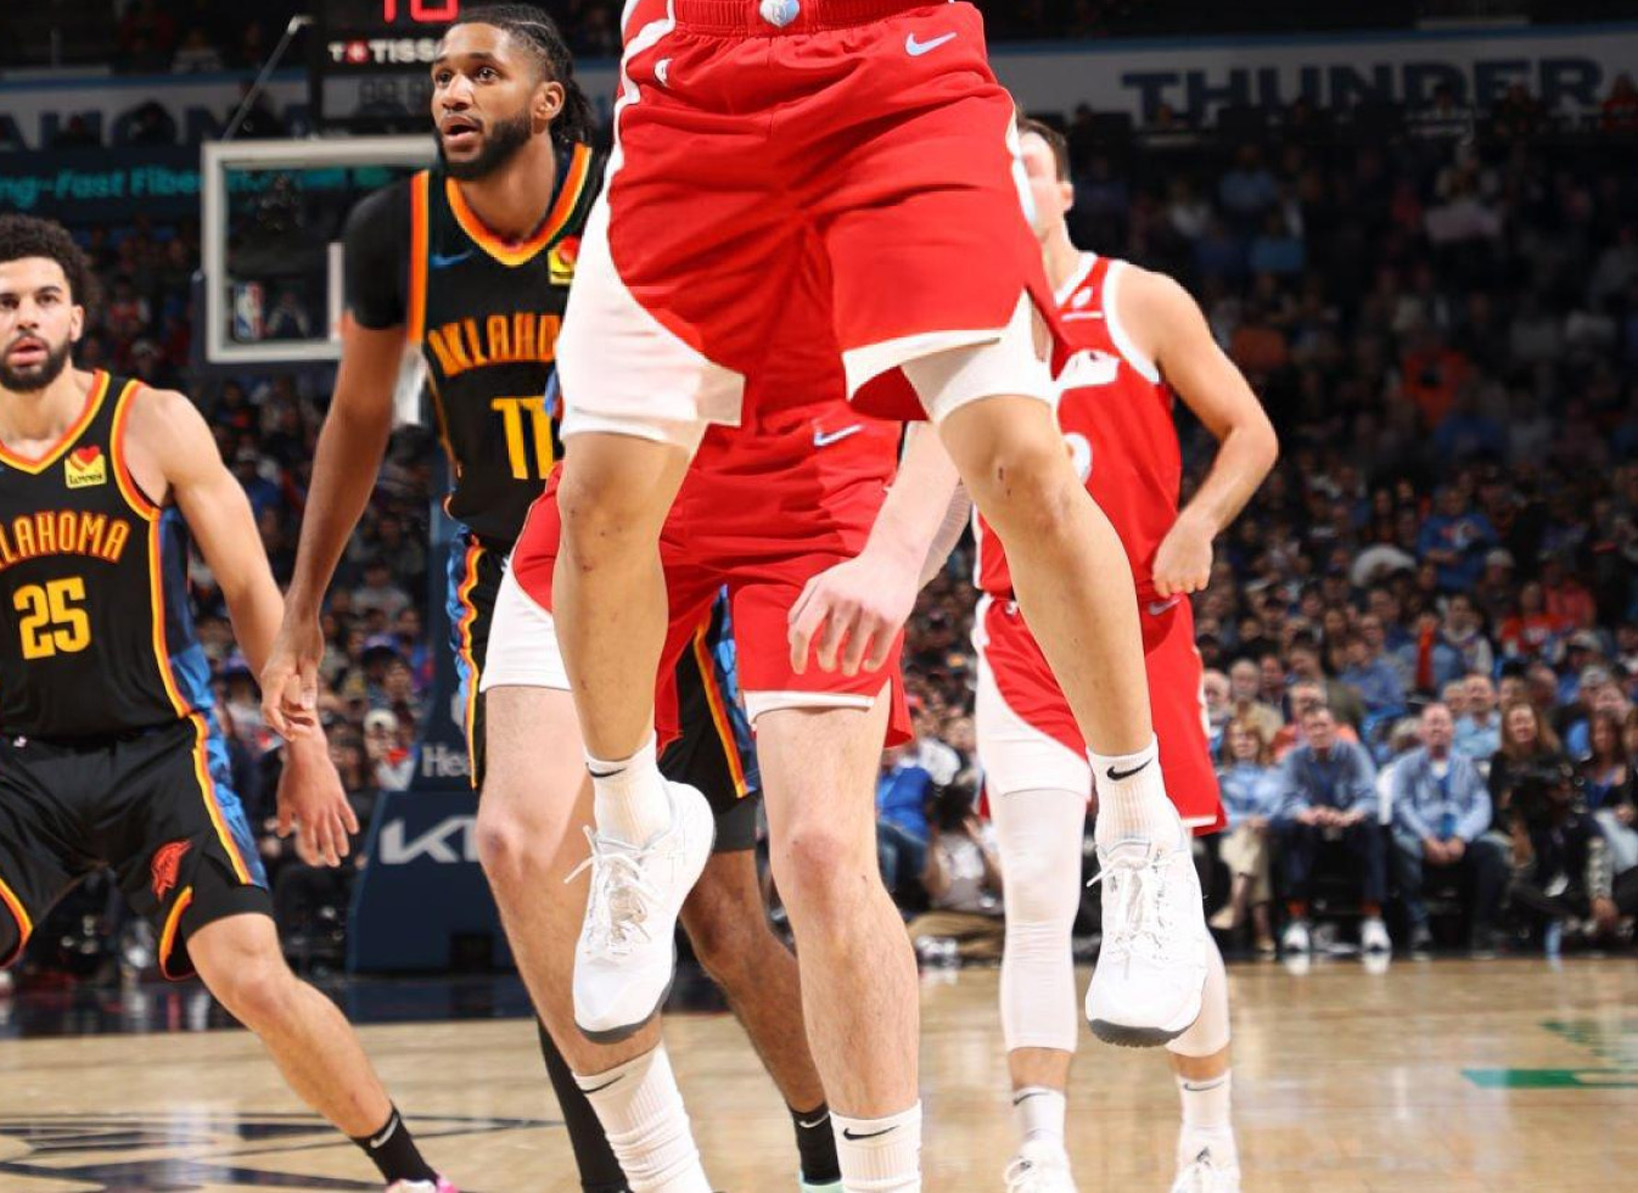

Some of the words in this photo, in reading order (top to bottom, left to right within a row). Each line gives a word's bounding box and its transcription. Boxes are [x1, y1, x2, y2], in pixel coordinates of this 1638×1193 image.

[368, 38, 445, 64] TISS
[1122, 58, 1603, 121] THUNDER
[490, 395, 554, 480] 11
[0, 509, 132, 570] LAHOMA
[13, 574, 92, 660] 25
